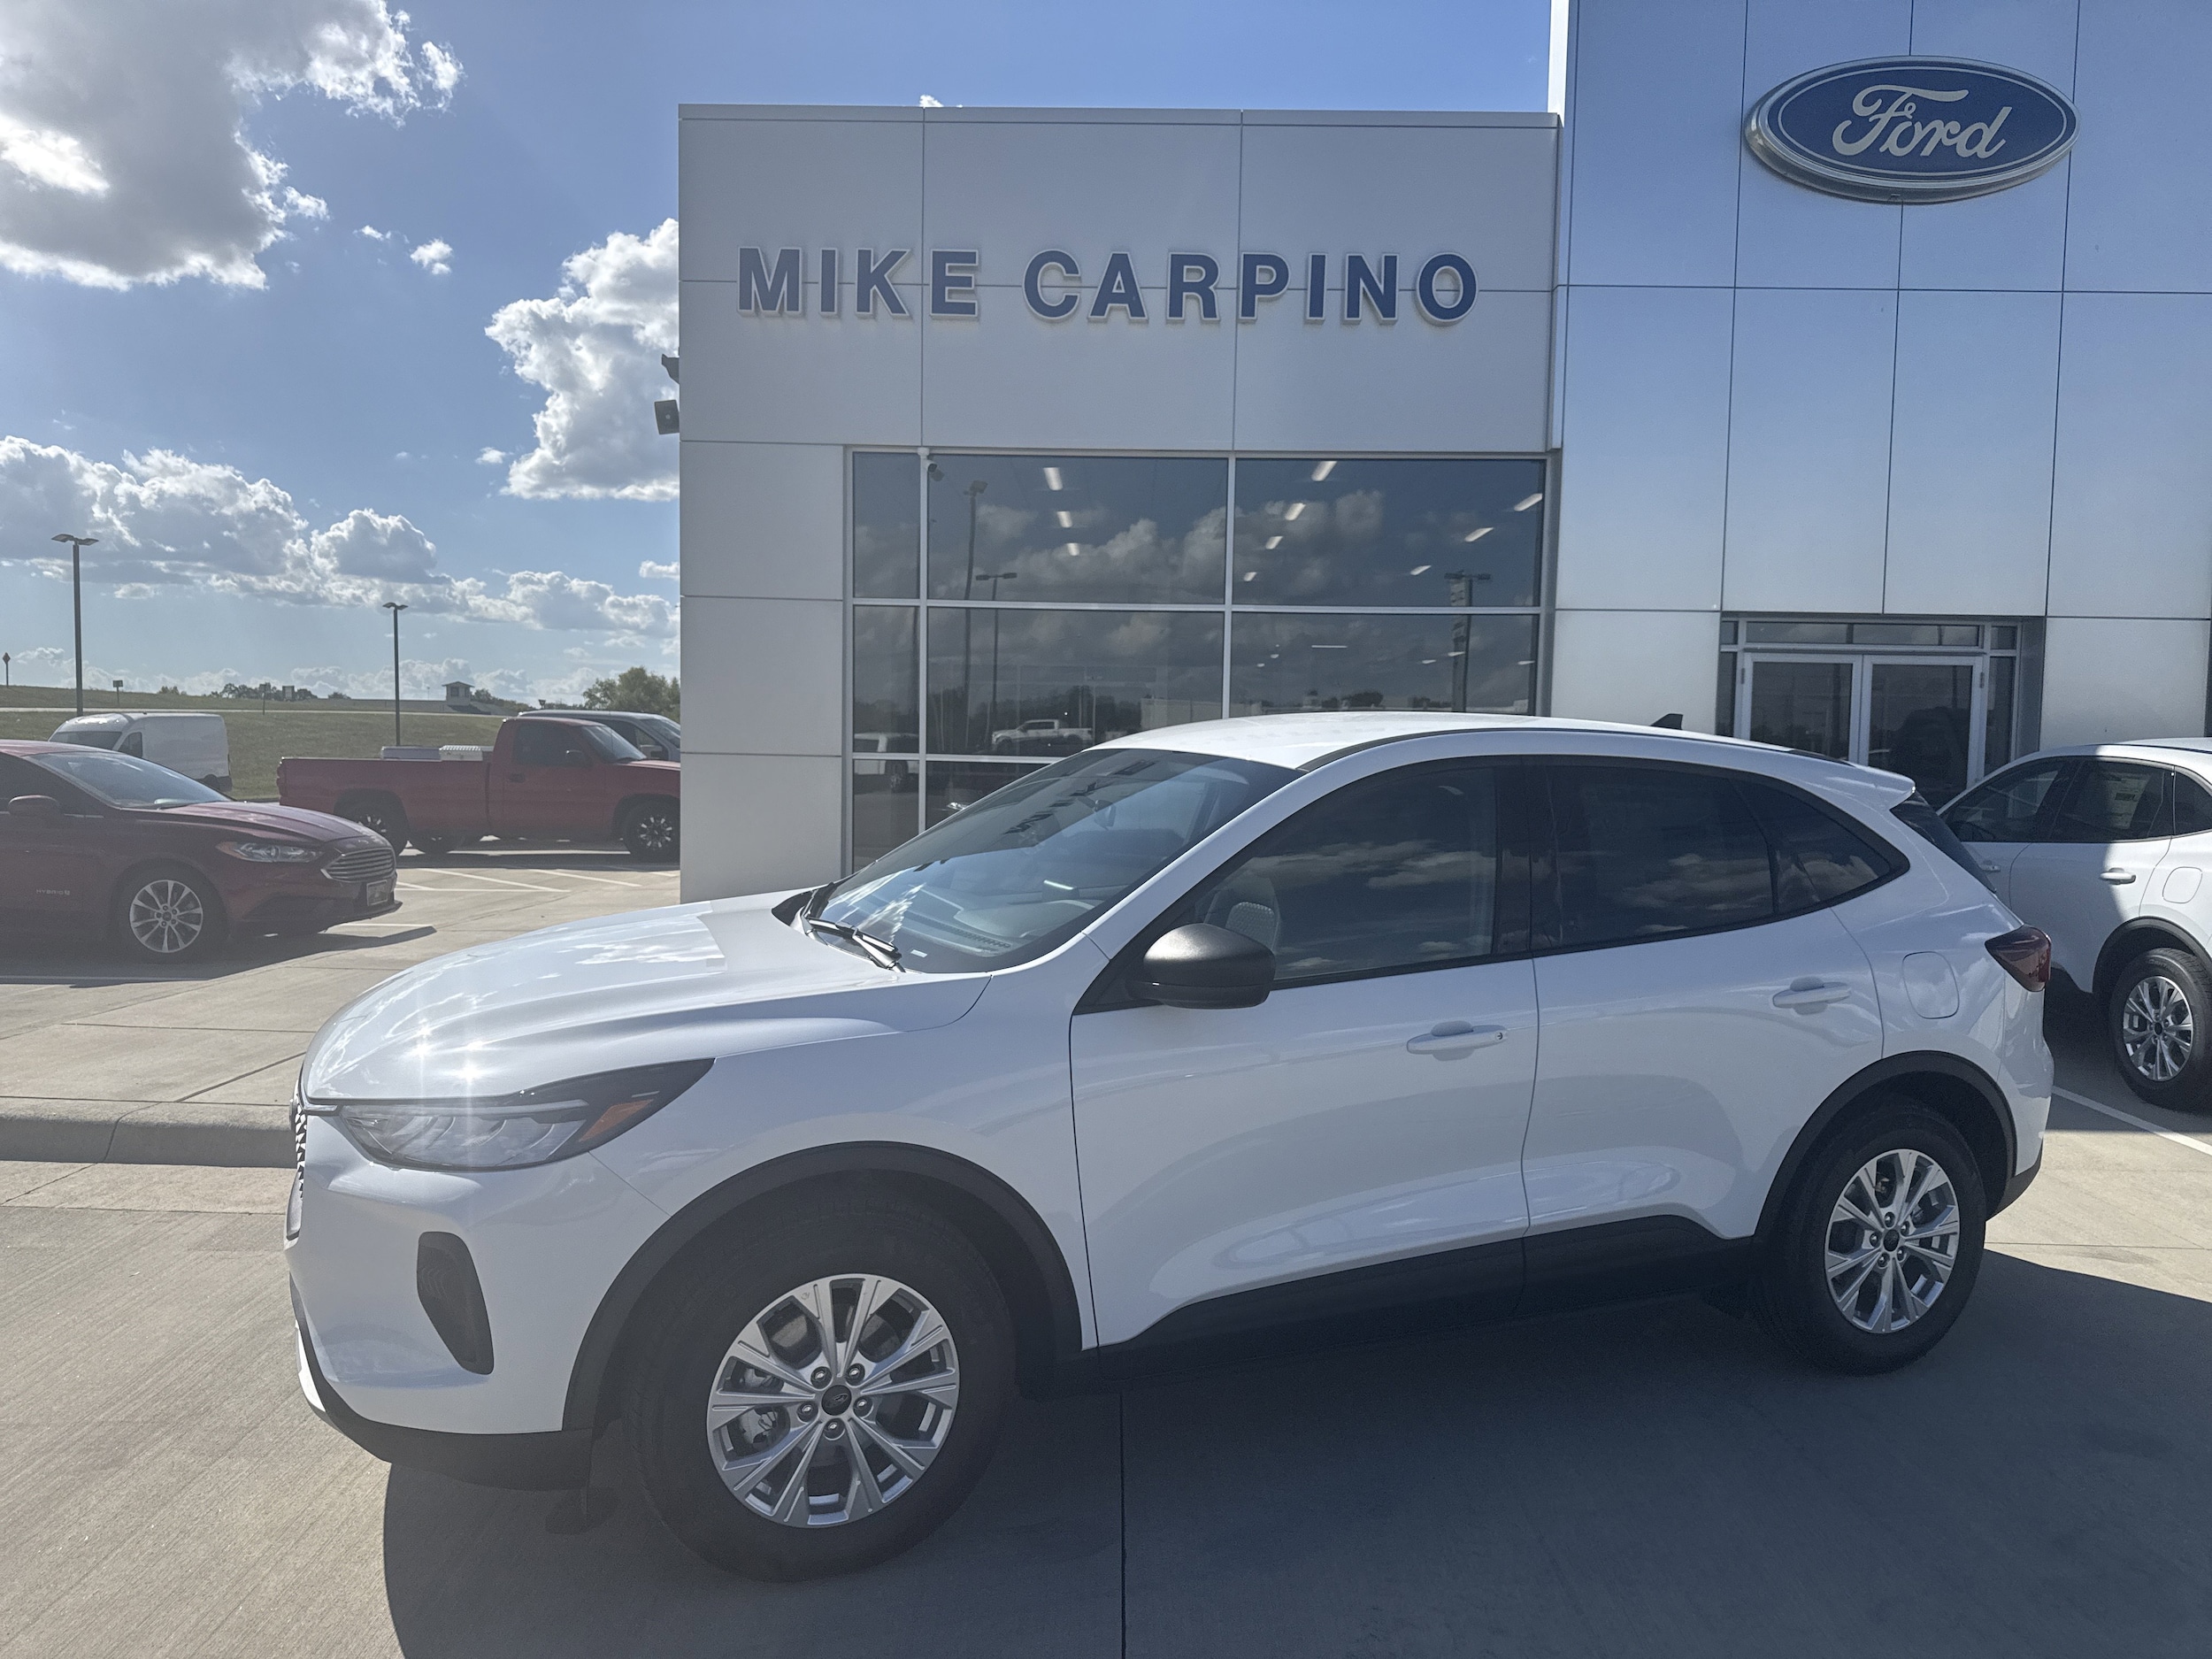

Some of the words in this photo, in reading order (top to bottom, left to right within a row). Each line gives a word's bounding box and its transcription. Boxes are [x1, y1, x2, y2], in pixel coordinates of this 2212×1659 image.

[1832, 83, 2013, 158] Ford
[737, 247, 980, 319] MIKE
[1022, 250, 1479, 326] CARPINO
